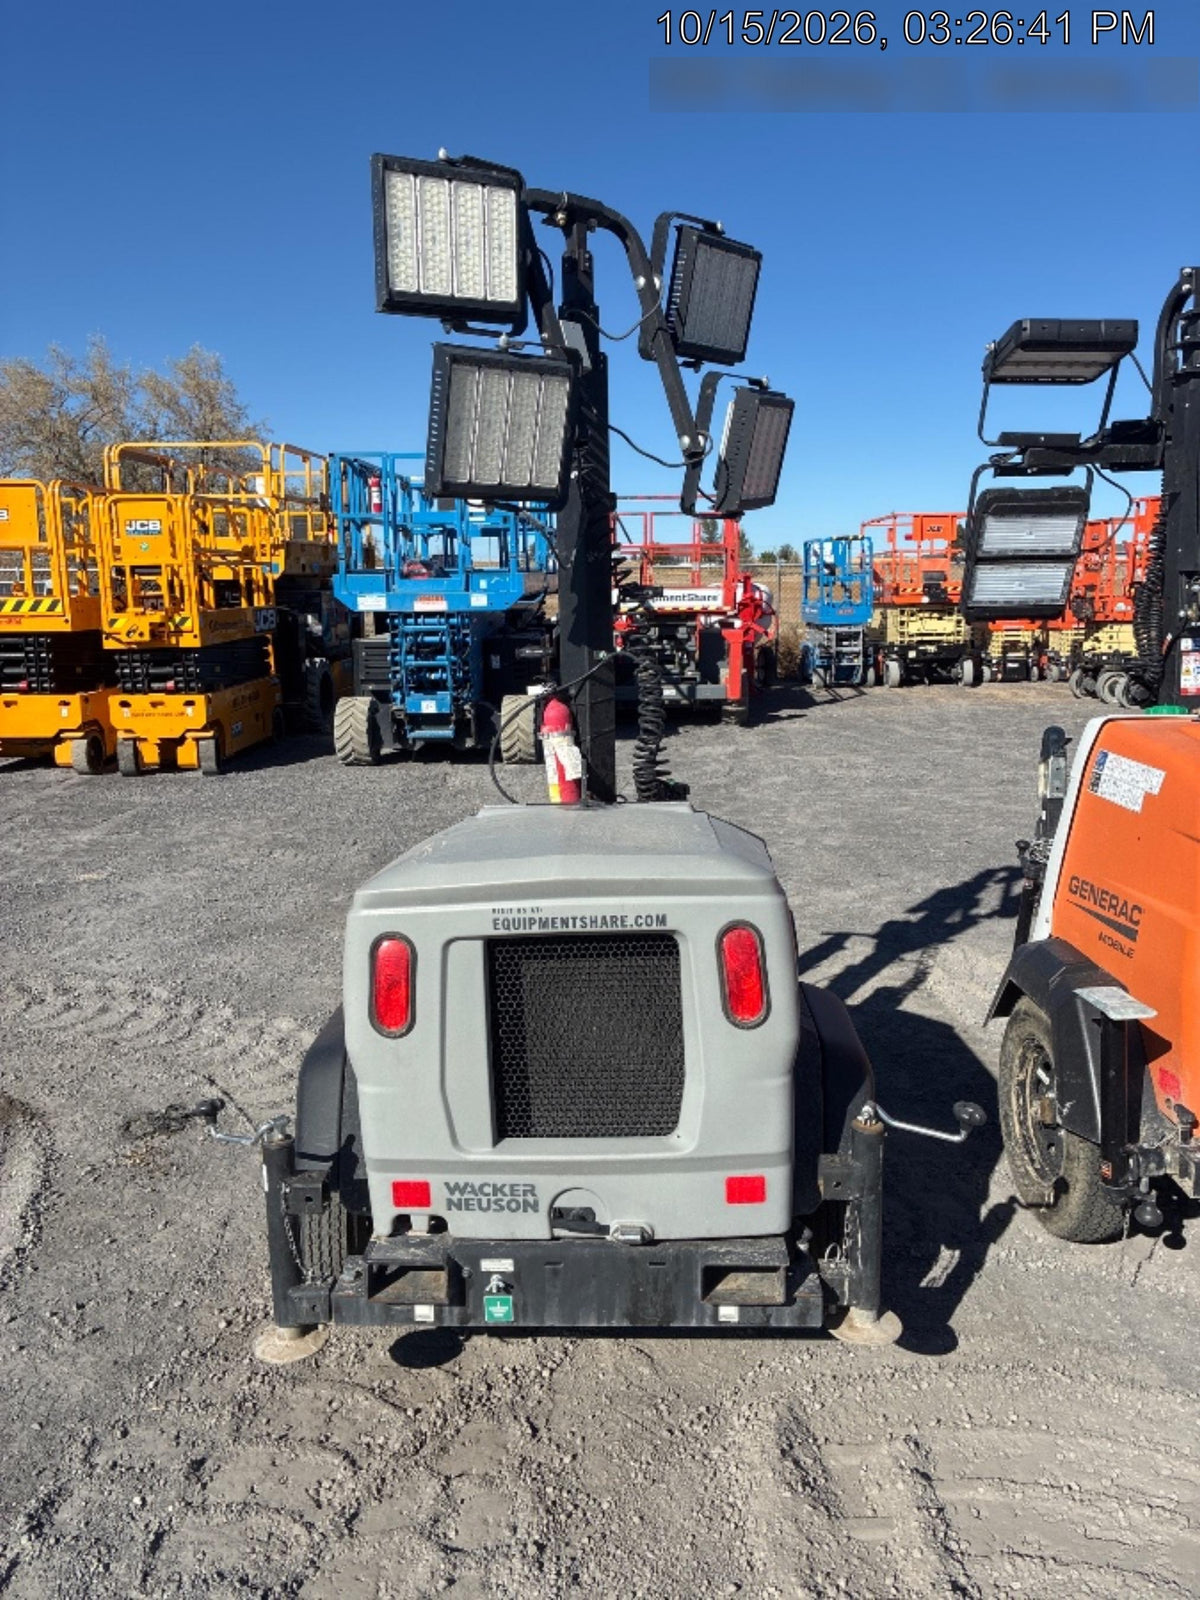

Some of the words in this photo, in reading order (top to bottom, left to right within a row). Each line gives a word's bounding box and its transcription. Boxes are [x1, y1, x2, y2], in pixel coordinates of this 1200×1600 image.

[126, 520, 161, 531] JCB
[652, 593, 719, 603] pmentShare
[255, 608, 277, 632] JCB
[1068, 874, 1144, 927] GENERAC
[492, 913, 667, 931] EQUIPMENTSHARE.COM
[443, 1181, 538, 1197] WACKER
[446, 1197, 539, 1213] NEUSON
